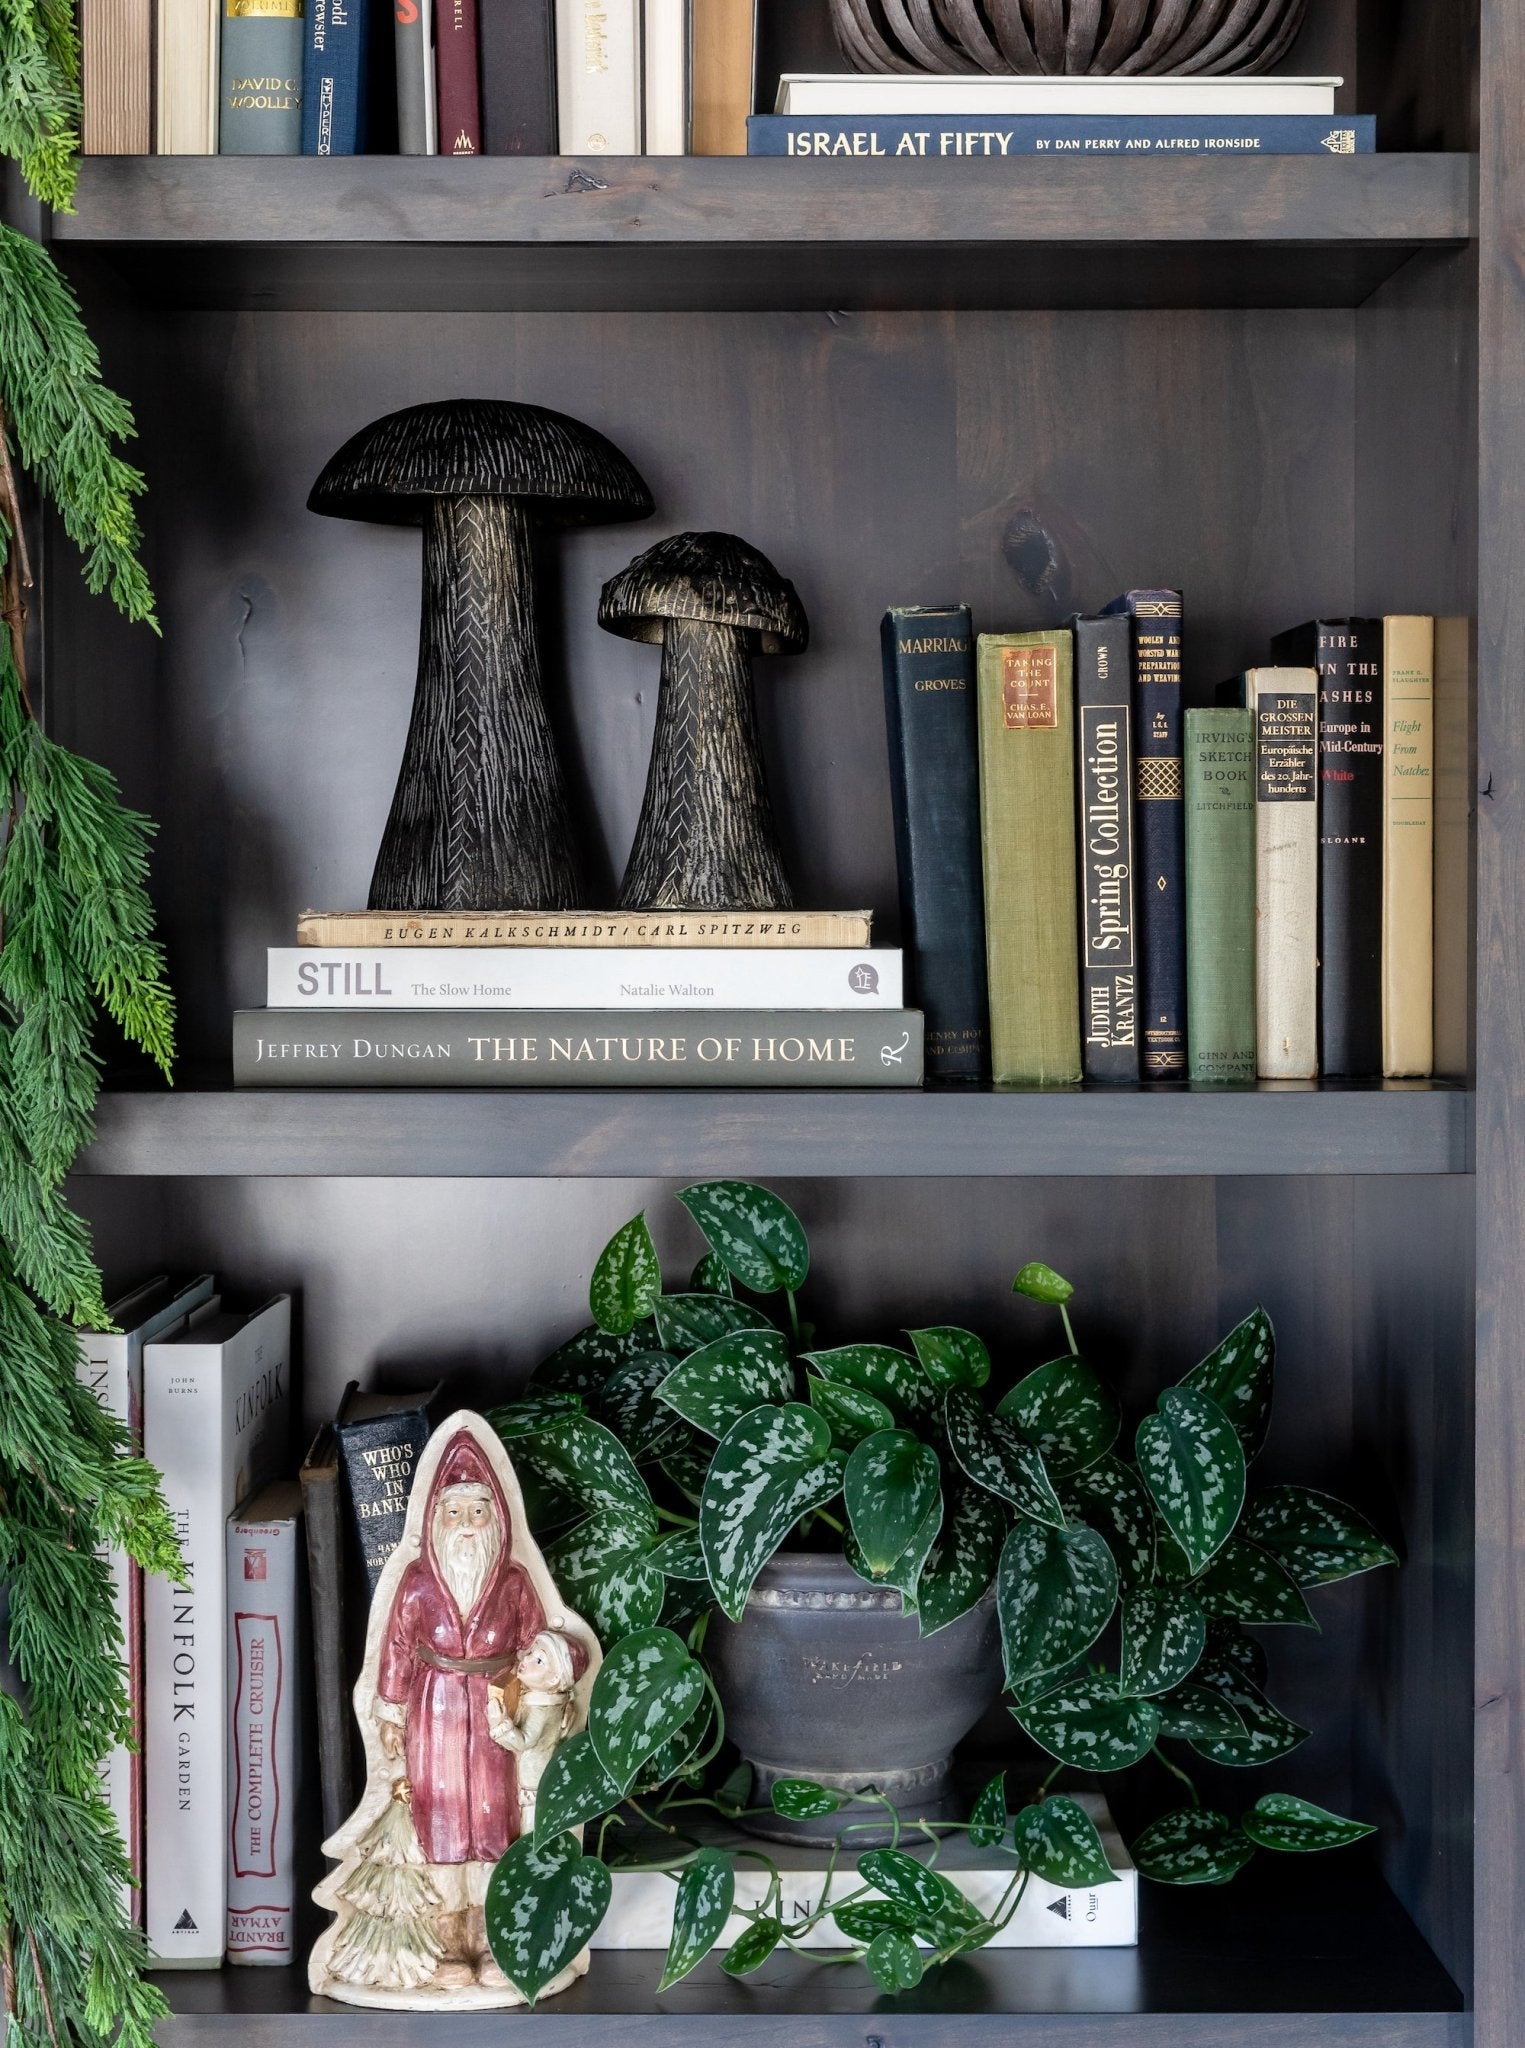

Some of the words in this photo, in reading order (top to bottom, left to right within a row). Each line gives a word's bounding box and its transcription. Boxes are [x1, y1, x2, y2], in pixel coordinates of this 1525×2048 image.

[231, 77, 281, 91] DAVID
[319, 94, 331, 155] HYPERIO
[787, 132, 886, 156] ISRAEL
[896, 132, 930, 156] AT
[940, 131, 1015, 156] FIFTY
[1036, 139, 1051, 149] BY
[1055, 139, 1080, 149] DAN
[1085, 139, 1121, 149] PERRY
[1125, 139, 1150, 149] AND
[1155, 138, 1199, 149] ALFRED
[1204, 138, 1260, 148] IRONSIDE
[1138, 636, 1164, 645] WOOLEN
[1319, 635, 1358, 648] FIRE
[1006, 659, 1052, 667] TAKING
[1097, 646, 1108, 679] CROWN
[1319, 663, 1337, 675] IN
[1347, 663, 1378, 675] THE
[1018, 669, 1042, 677] THE
[1138, 674, 1152, 683] AND
[914, 679, 966, 691] GROVES
[1319, 690, 1373, 703] ASHES
[1277, 699, 1298, 709] DIE
[1007, 711, 1025, 719] VAN
[1260, 712, 1314, 722] GROSSEN
[1261, 725, 1312, 736] MEISTER
[1319, 721, 1358, 735] Europe
[1360, 721, 1371, 733] in
[1393, 720, 1422, 736] Flight
[1195, 732, 1254, 743] IRVING'S
[1319, 740, 1384, 755] Mid-Century
[1393, 744, 1418, 754] From
[1199, 752, 1252, 762] SKETCH
[1269, 757, 1306, 768] Erzähler
[1203, 770, 1248, 780] BOOK
[1260, 771, 1276, 781] des
[1321, 769, 1355, 781] White
[1393, 764, 1430, 777] Natchez
[1088, 721, 1120, 856] Collection
[1268, 783, 1307, 793] hunderts
[1196, 802, 1254, 810] LITCHFIELD
[1091, 863, 1129, 950] Spring
[384, 926, 455, 940] EUGEN
[464, 925, 618, 939] KALKSCHMIDT
[637, 924, 688, 936] CARL
[697, 922, 802, 936] SPITZWEG
[297, 961, 392, 996] STILL
[411, 983, 436, 996] The
[439, 983, 470, 996] Slow
[472, 983, 512, 996] Home
[620, 983, 665, 996] Natalie
[668, 983, 714, 996] Walton
[1086, 986, 1110, 1048] JUDITH
[1111, 974, 1135, 1047] KRANTZ
[467, 1037, 538, 1061] THE
[548, 1037, 687, 1061] NATURE
[696, 1037, 742, 1061] OF
[751, 1037, 856, 1061] HOME
[1198, 1051, 1228, 1060] GINN
[1232, 1051, 1255, 1060] AND
[1198, 1063, 1255, 1073] COMPANY
[235, 1363, 284, 1435] KINFOLK
[362, 1443, 414, 1467] WHO'S
[371, 1461, 411, 1482] WHO
[384, 1479, 404, 1497] IN
[359, 1495, 410, 1519] BANK
[178, 1509, 190, 1547] THE
[234, 1526, 280, 1536] Greenberg
[250, 1637, 265, 1716] CRUISER
[178, 1732, 191, 1811] GARDEN
[248, 1723, 263, 1821] COMPLETE
[250, 1826, 262, 1856] THE
[231, 1917, 281, 1928] AYMAR
[229, 1931, 285, 1943] BRANDT
